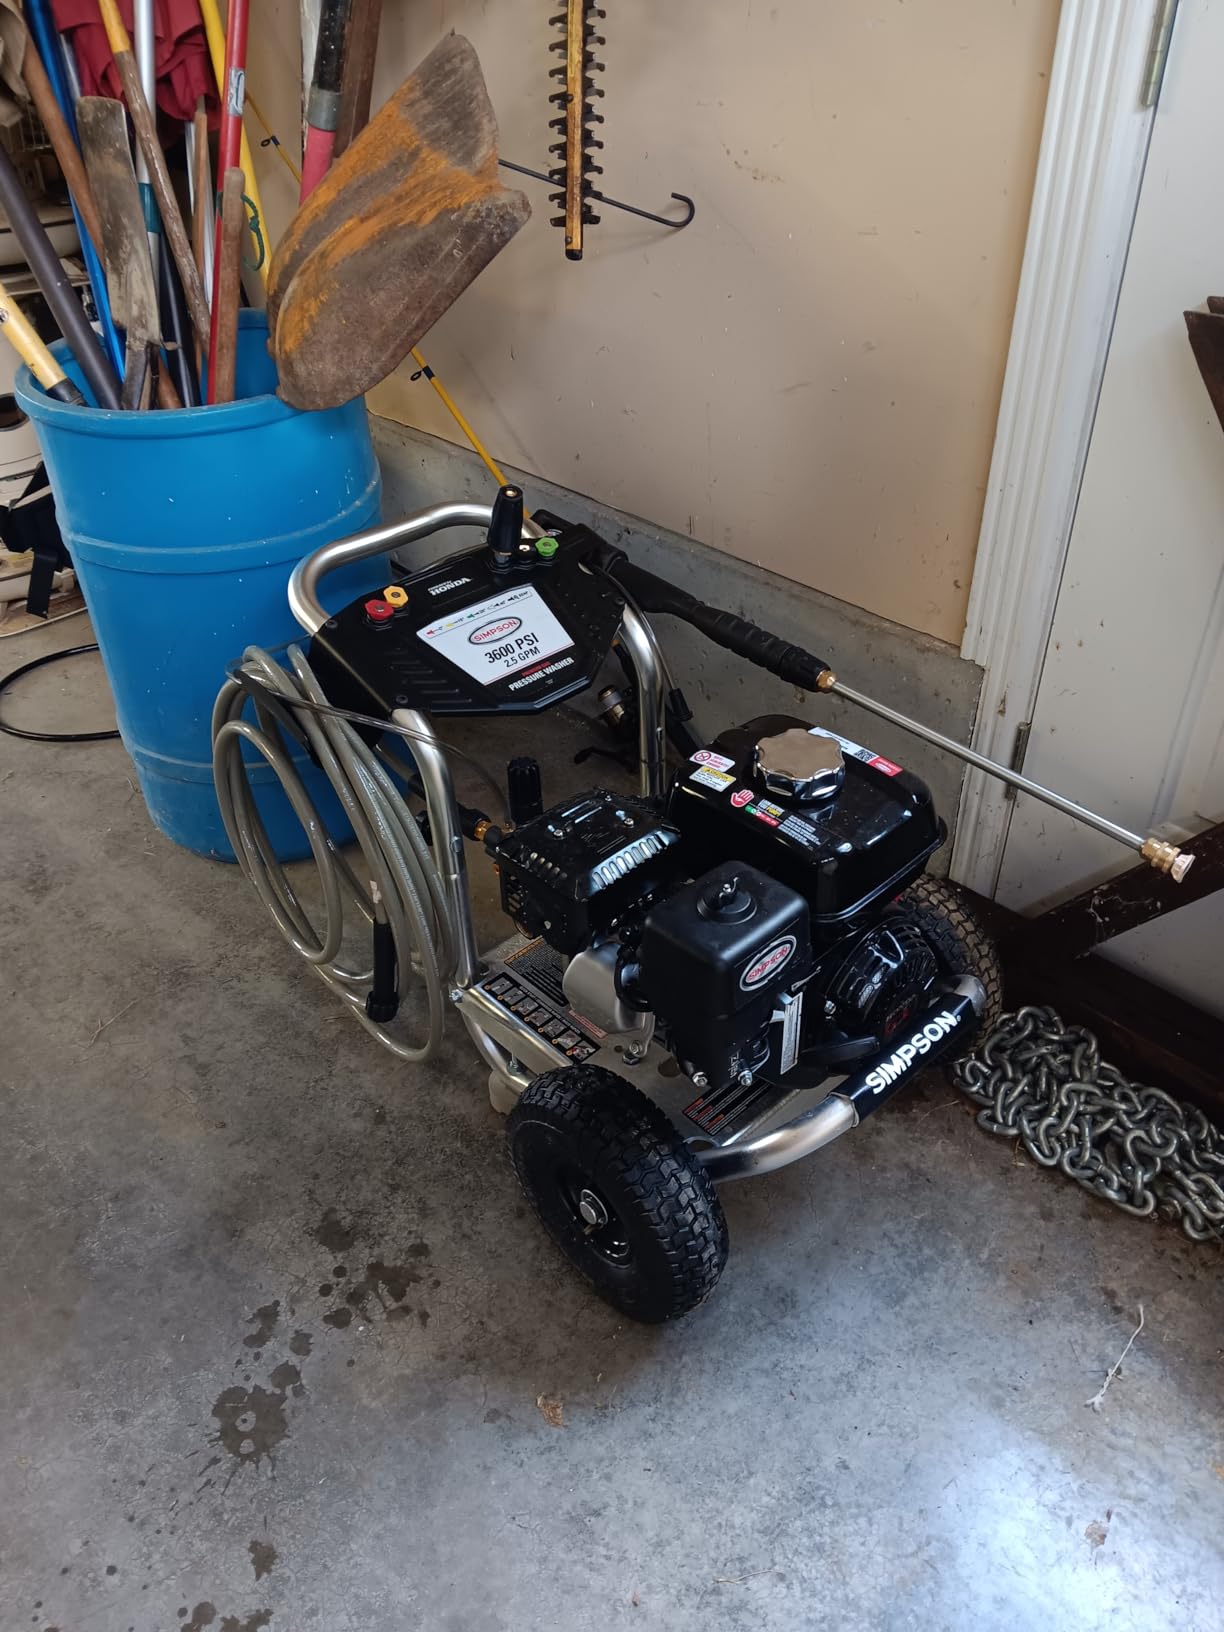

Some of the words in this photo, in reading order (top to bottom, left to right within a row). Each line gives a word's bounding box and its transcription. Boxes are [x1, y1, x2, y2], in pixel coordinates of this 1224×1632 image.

[429, 577, 472, 596] HONDA
[473, 619, 518, 641] SIMPSON
[484, 643, 515, 663] 3600
[515, 632, 539, 650] PSI
[503, 656, 518, 668] 2.5
[517, 646, 541, 661] GPM
[508, 670, 546, 691] PRESSURE
[543, 657, 575, 674] WASHER
[748, 945, 791, 979] SIMPSON
[865, 1010, 959, 1094] SIMPSON
